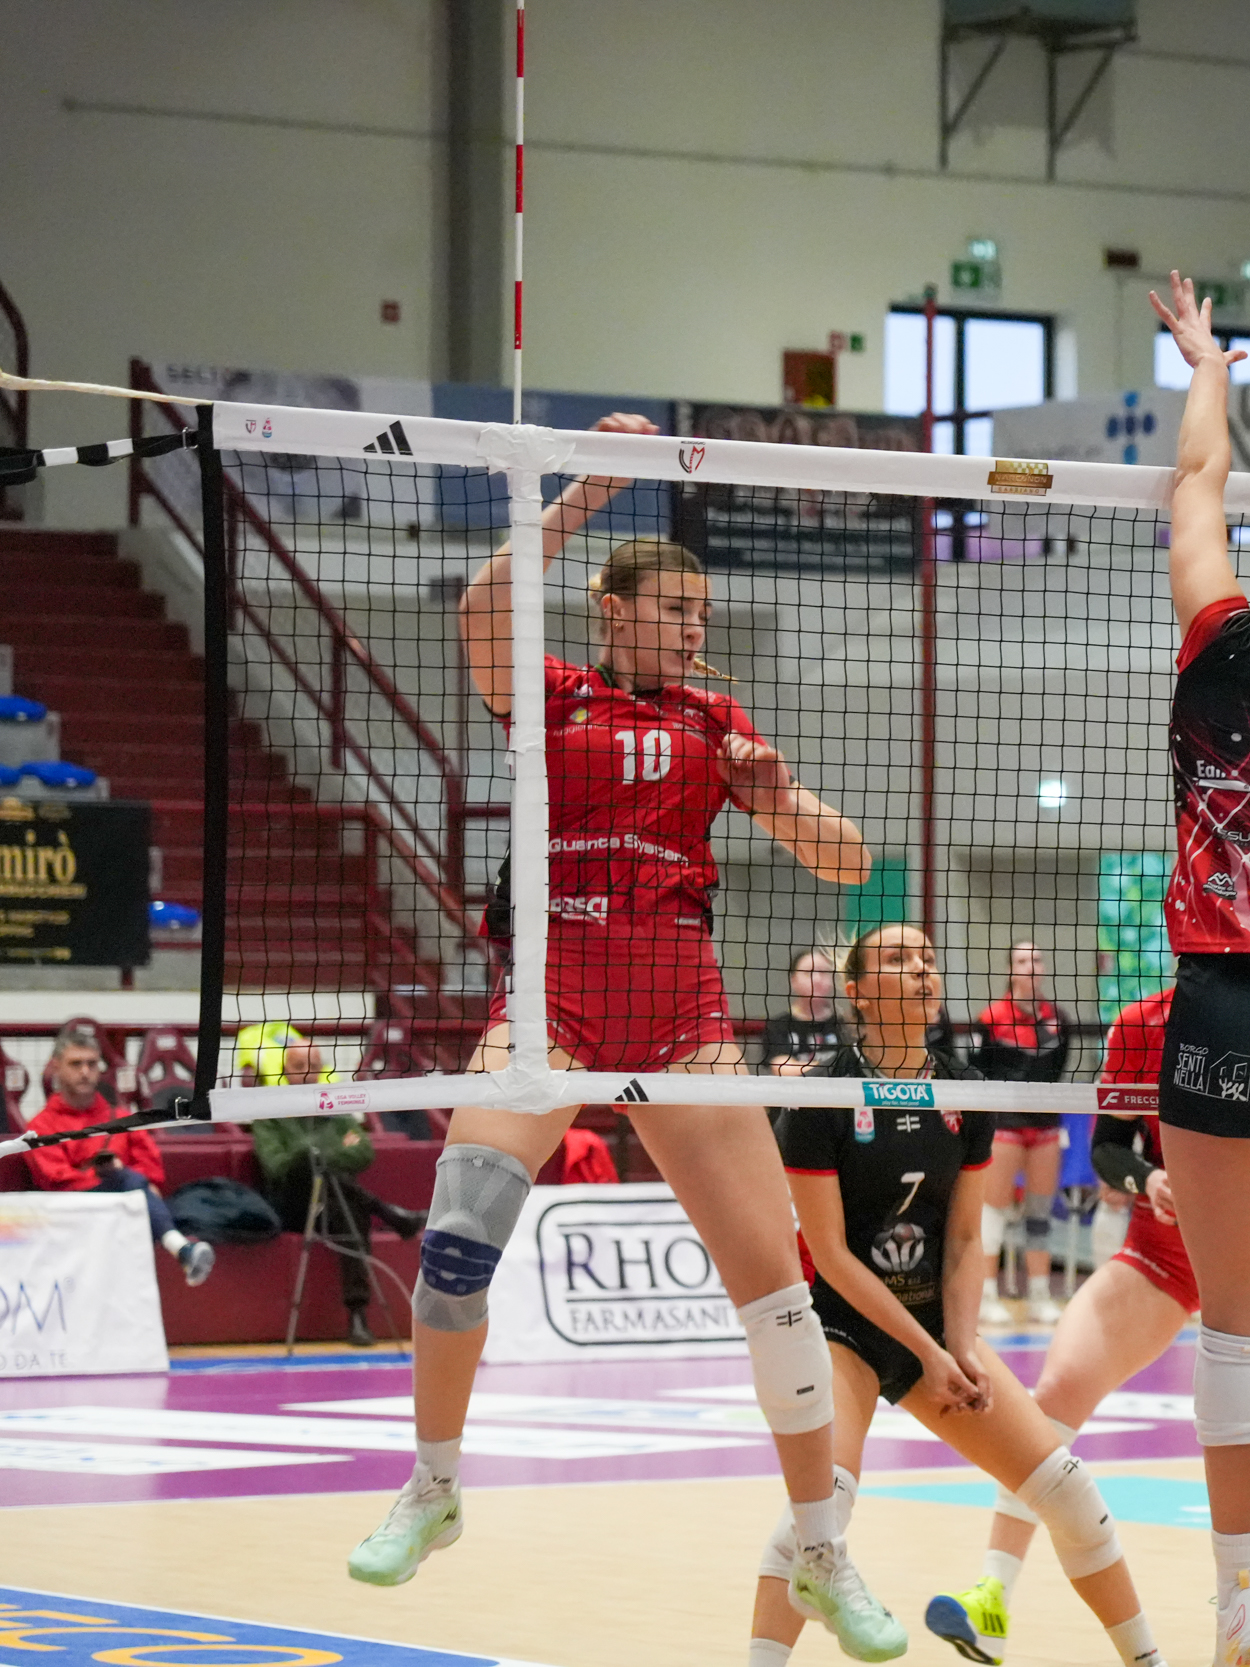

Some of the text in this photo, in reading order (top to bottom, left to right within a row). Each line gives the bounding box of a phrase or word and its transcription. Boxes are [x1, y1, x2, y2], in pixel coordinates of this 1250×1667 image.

[615, 729, 672, 785] 10
[548, 837, 620, 853] Quanta
[1180, 1043, 1209, 1055] BORGO
[1176, 1052, 1206, 1074] SENTI
[1173, 1069, 1204, 1091] NELLA
[896, 1171, 926, 1215] 7
[562, 1232, 724, 1291] RHO
